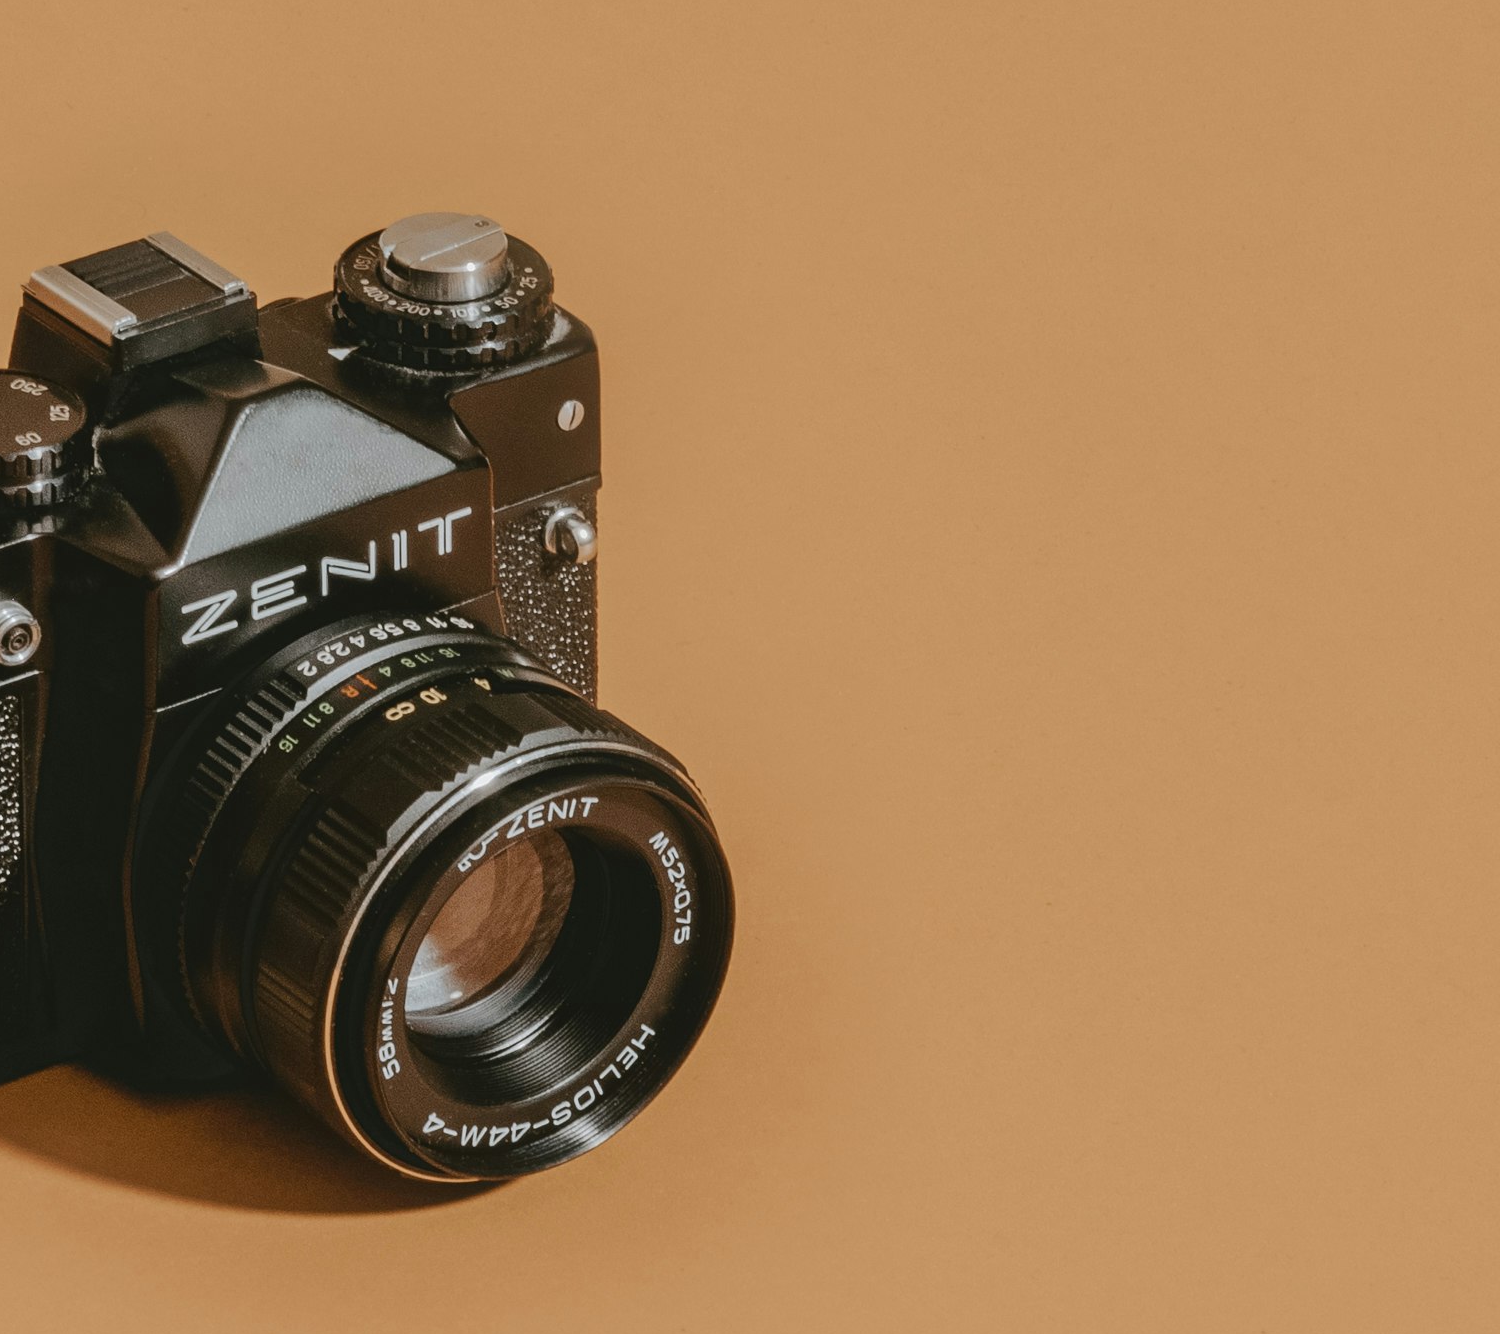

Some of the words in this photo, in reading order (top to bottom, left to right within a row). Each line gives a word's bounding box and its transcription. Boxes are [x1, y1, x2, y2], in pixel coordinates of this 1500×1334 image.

[363, 285, 389, 302] 400
[396, 302, 430, 316] 200
[493, 296, 518, 309] 50
[520, 276, 538, 289] 25
[9, 379, 48, 396] 250
[49, 404, 69, 421] 125
[15, 430, 42, 447] 60
[180, 505, 472, 646] ZENIT
[369, 622, 404, 640] 5,6
[402, 618, 421, 631] 8
[348, 634, 365, 648] 4
[316, 641, 351, 665] 2,8
[296, 660, 318, 677] 2
[419, 686, 447, 704] 10
[506, 797, 599, 839] ZENIT
[648, 831, 691, 946] M52x0,75
[422, 1023, 655, 1147] HELIOS-44M-4
